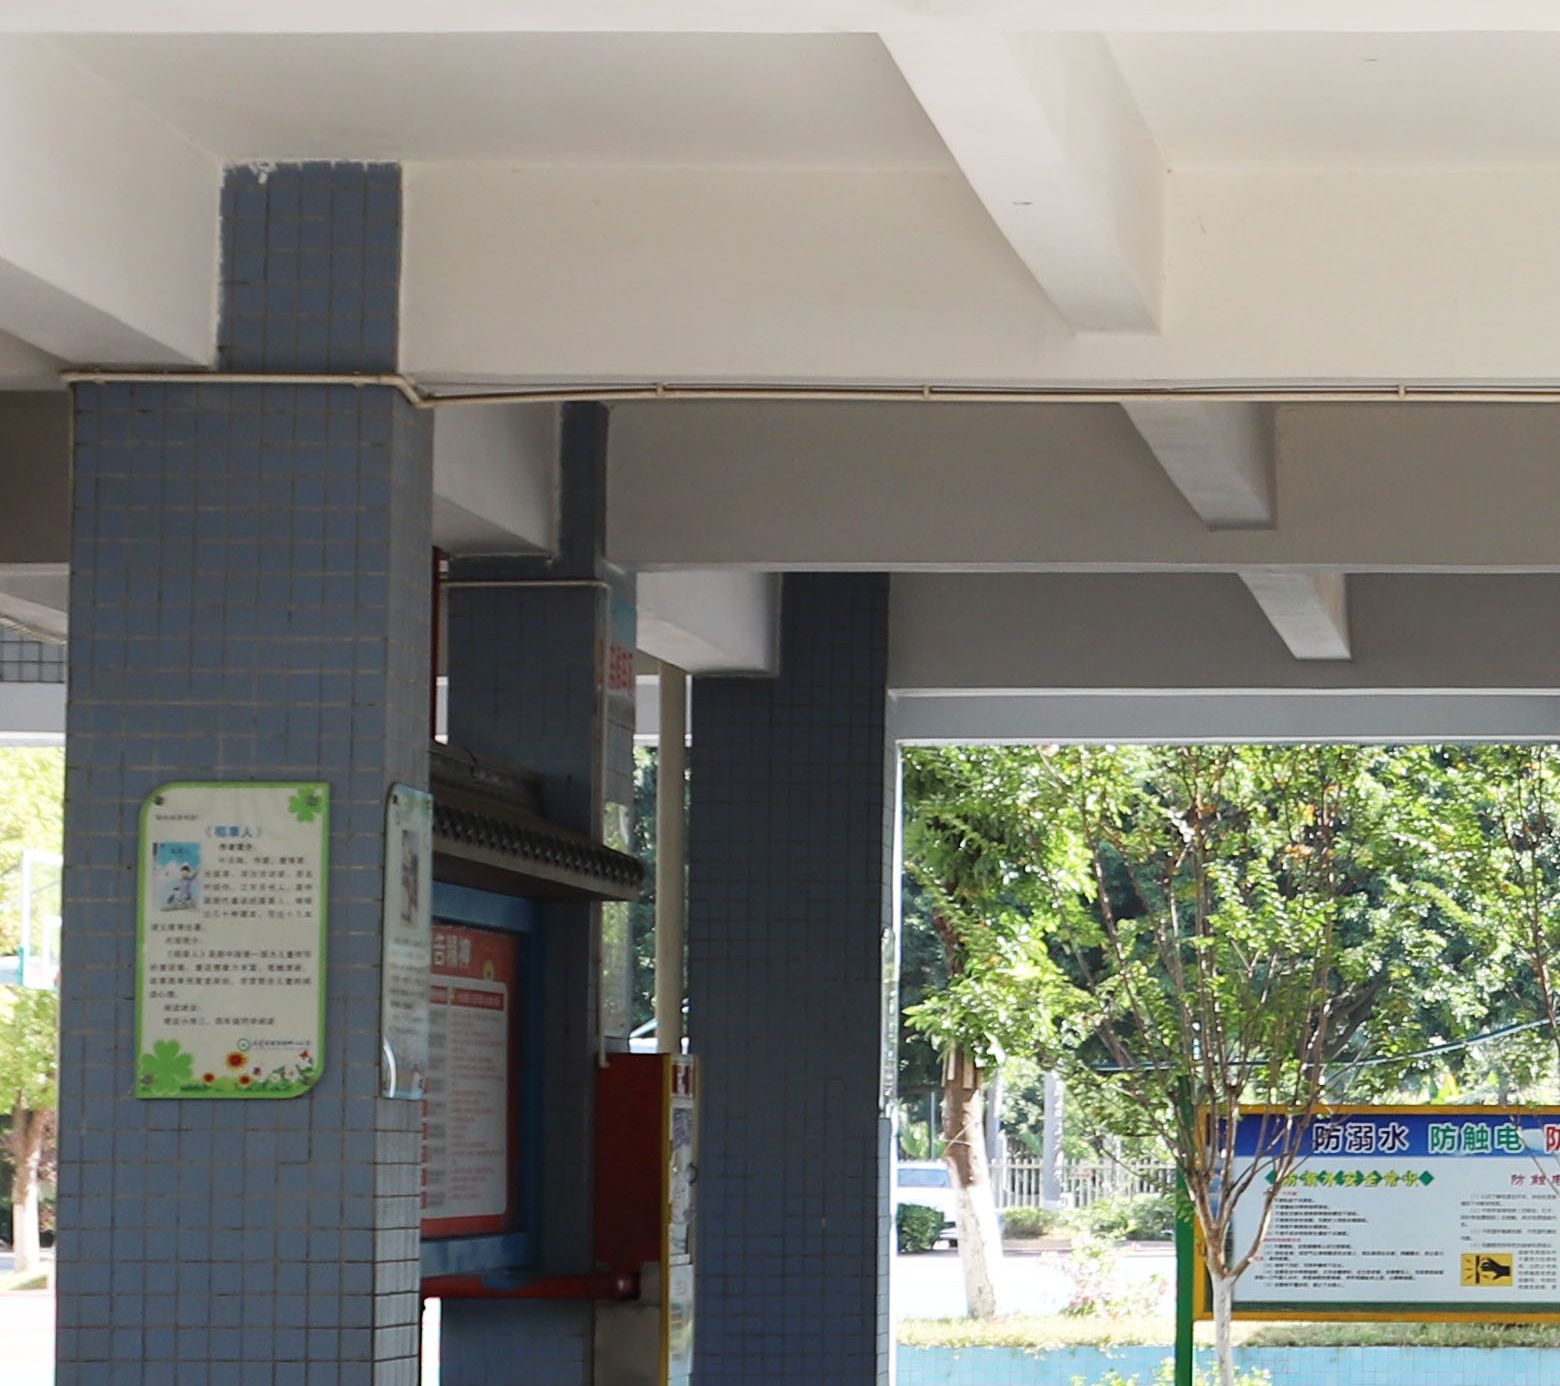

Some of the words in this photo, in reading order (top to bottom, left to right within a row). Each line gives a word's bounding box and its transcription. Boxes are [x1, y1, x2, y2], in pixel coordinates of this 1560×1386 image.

[1312, 1122, 1410, 1154] 防溺水
[1428, 1122, 1524, 1154] 防触电
